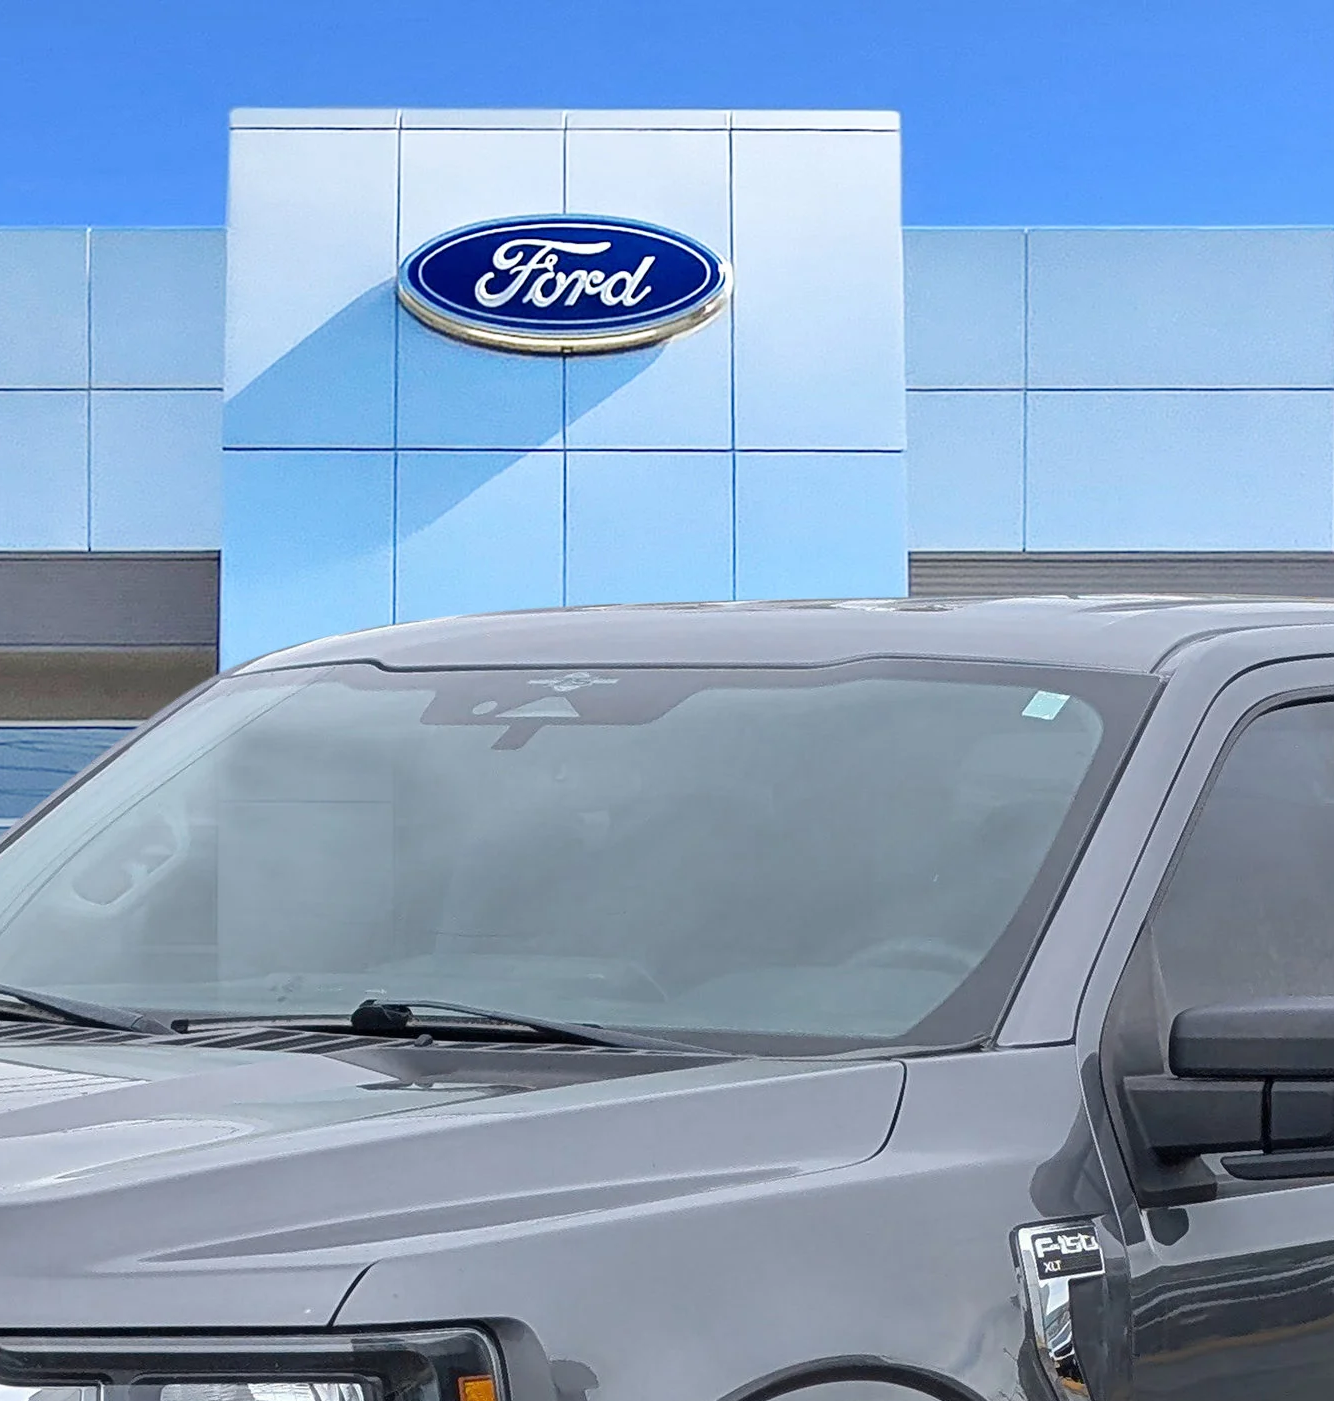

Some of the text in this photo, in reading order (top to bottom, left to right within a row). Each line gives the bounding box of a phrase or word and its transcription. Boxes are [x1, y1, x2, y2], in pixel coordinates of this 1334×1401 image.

[475, 238, 655, 308] Ford
[1034, 1232, 1099, 1258] F-150
[1043, 1260, 1062, 1273] XLT
